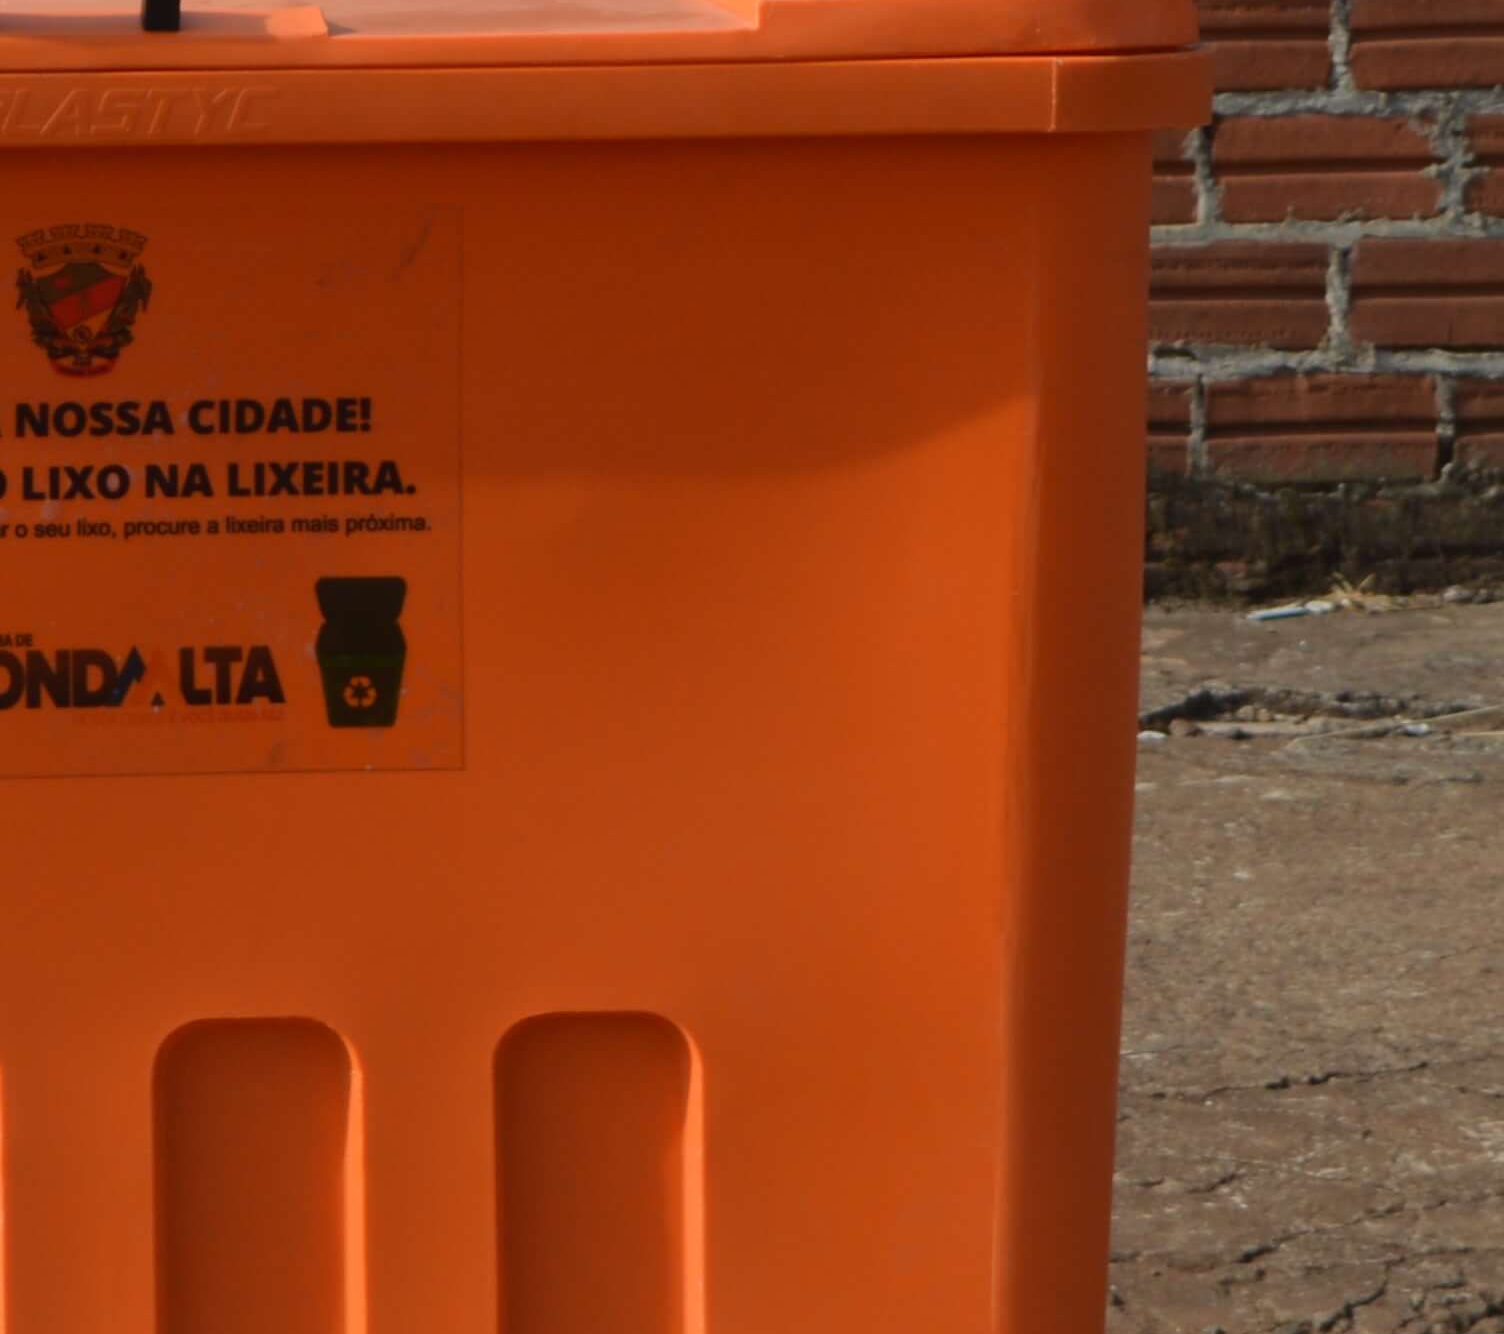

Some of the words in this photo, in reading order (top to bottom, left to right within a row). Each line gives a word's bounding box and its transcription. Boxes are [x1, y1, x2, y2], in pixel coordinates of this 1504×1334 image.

[14, 400, 175, 438] NOSSA
[188, 397, 372, 435] CIDADE!
[21, 464, 131, 501] LIXO
[144, 463, 214, 498] NA
[226, 460, 417, 496] LIXEIRA.
[14, 525, 28, 539] o
[33, 524, 71, 539] seu
[76, 518, 117, 540] lixo,
[123, 520, 201, 540] procure
[206, 521, 220, 535] a
[225, 516, 285, 534] lixeira
[291, 515, 339, 533] mais
[345, 513, 432, 536] próxima.
[15, 634, 33, 648] DE
